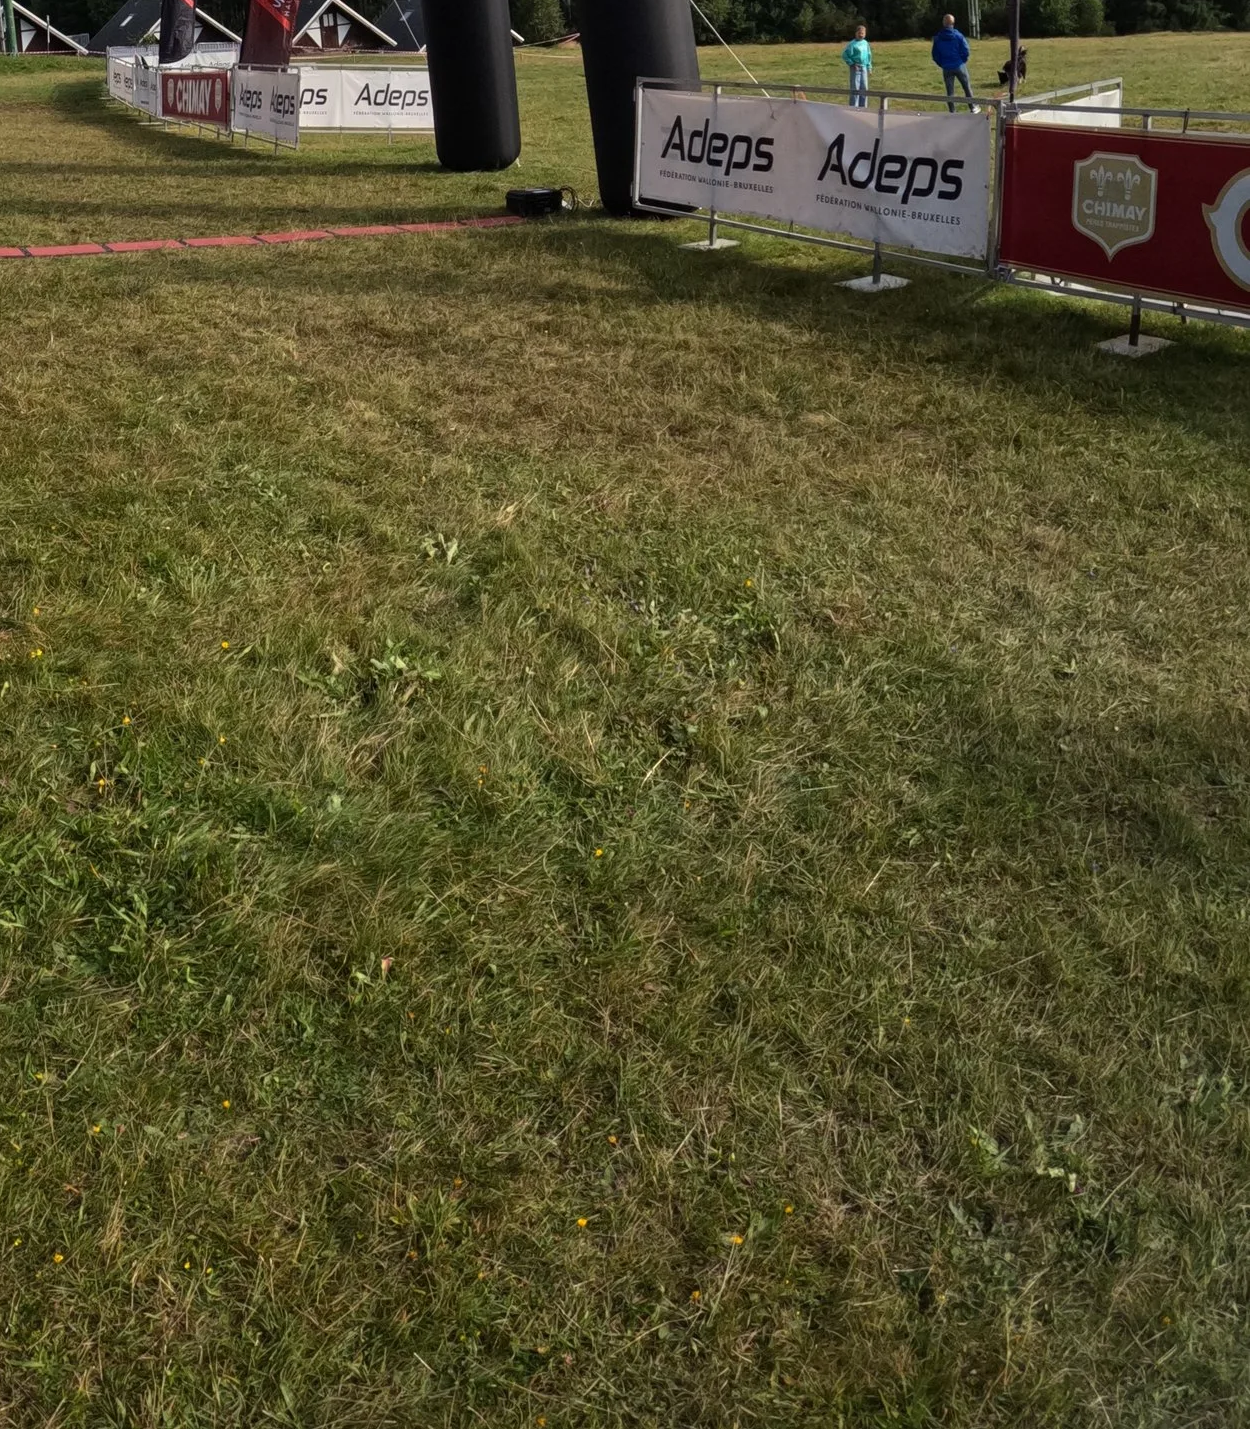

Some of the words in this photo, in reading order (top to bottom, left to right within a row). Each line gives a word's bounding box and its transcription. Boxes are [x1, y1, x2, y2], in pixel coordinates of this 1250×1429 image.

[176, 78, 212, 116] CHIMAY
[355, 83, 429, 110] Adeps
[661, 115, 774, 176] Adeps
[817, 133, 965, 204] Adeps
[1081, 199, 1147, 221] CHIMAY
